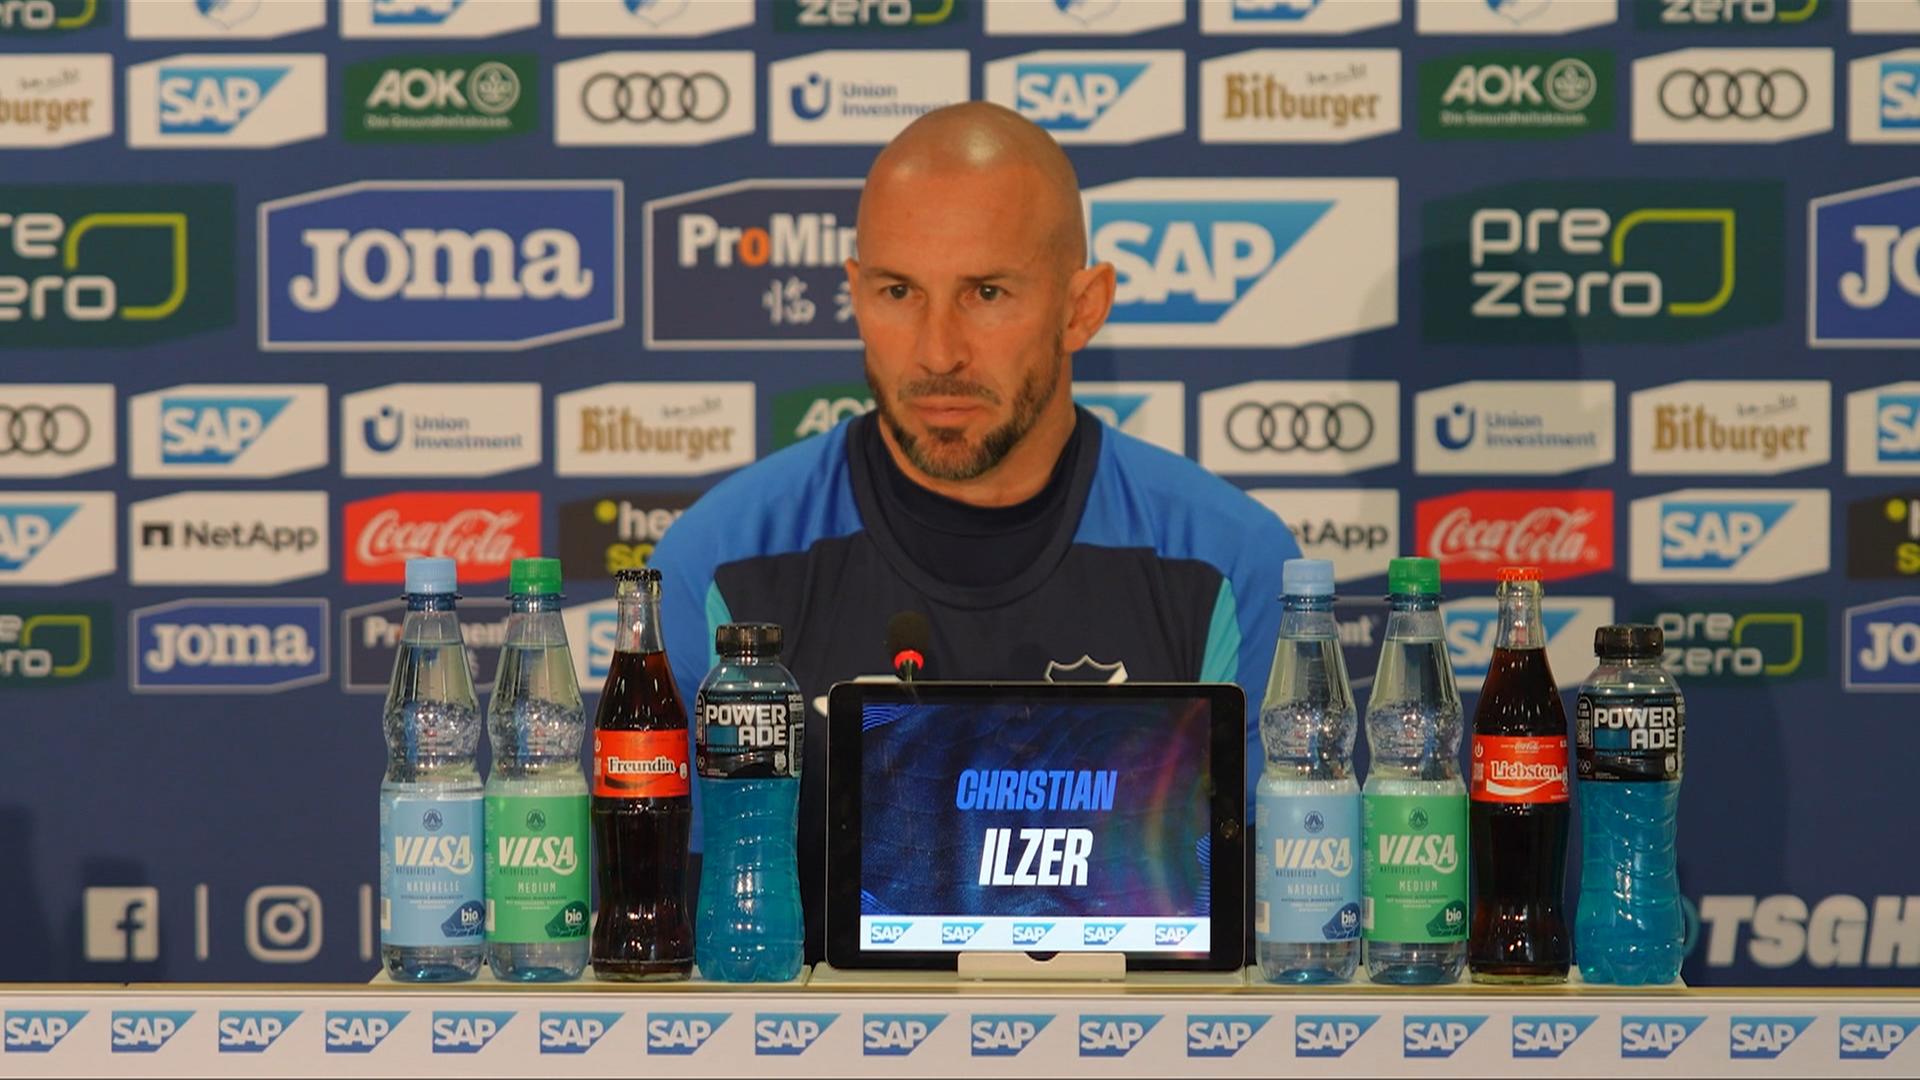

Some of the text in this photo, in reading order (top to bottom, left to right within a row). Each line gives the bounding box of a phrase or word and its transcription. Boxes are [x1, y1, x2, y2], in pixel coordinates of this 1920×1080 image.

[160, 77, 262, 125] SAP
[366, 68, 468, 109] AOK
[841, 82, 897, 98] Union
[1018, 73, 1120, 120] SAP
[1224, 71, 1382, 129] Bitburger
[1441, 64, 1545, 106] AOK
[678, 212, 858, 268] ProMin
[1471, 208, 1611, 267] pre
[1093, 220, 1275, 306] SAP
[0, 275, 116, 321] ero
[1471, 271, 1662, 317] zero
[162, 407, 262, 455] SAP
[413, 415, 470, 431] Union
[578, 403, 735, 460] Bitburger
[1485, 411, 1543, 427] Union
[1653, 402, 1811, 460] Bitburger
[182, 520, 319, 553] NetApp
[1662, 511, 1764, 559] SAP
[705, 703, 787, 726] POWER
[1593, 706, 1676, 729] POWER
[738, 725, 787, 747] ADE
[1631, 728, 1676, 750] ADE
[608, 756, 676, 775] Freundin
[1491, 761, 1558, 780] Liebsten
[955, 769, 1118, 812] CHRISTIAN
[395, 835, 474, 875] VILSA
[498, 836, 578, 876] VILSA
[978, 828, 1094, 885] ILZER
[1275, 837, 1353, 878] VILSA
[1379, 834, 1459, 874] VILSA
[406, 880, 460, 893] NATURELLE
[517, 880, 557, 894] MEDIUM
[1287, 883, 1341, 896] NATURELLE
[1399, 879, 1438, 893] MEDIUM
[461, 908, 479, 922] bio
[565, 908, 583, 922] bio
[1341, 910, 1357, 925] bio
[1445, 907, 1462, 922] bio
[871, 925, 1188, 942] SAP SAP SAP SAP SAP
[6, 1017, 1904, 1052] SAP SAP SAP SAP SAP SAP SAP SAP SAP SAP SAP SAP SAP SAP SAP SAP SAP SAP
